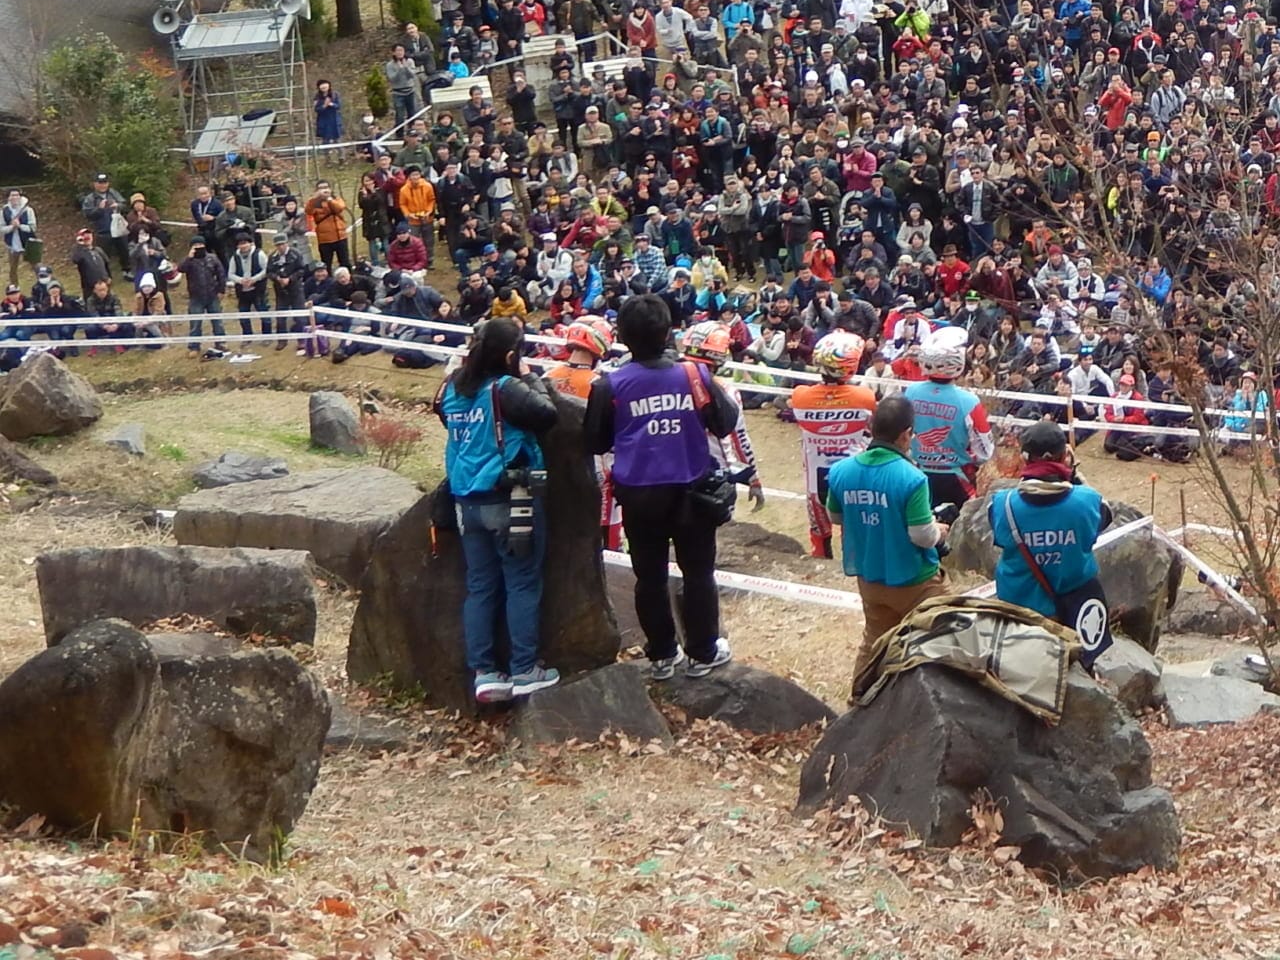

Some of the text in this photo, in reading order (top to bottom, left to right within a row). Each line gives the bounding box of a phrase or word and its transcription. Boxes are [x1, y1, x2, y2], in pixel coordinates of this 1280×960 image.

[630, 393, 694, 417] MEDIA
[804, 411, 861, 420] REPSOL
[647, 419, 681, 435] 035
[808, 437, 857, 446] HONDA
[843, 490, 888, 508] MEDIA
[1023, 529, 1076, 547] MEDIA
[1035, 551, 1062, 567] 072
